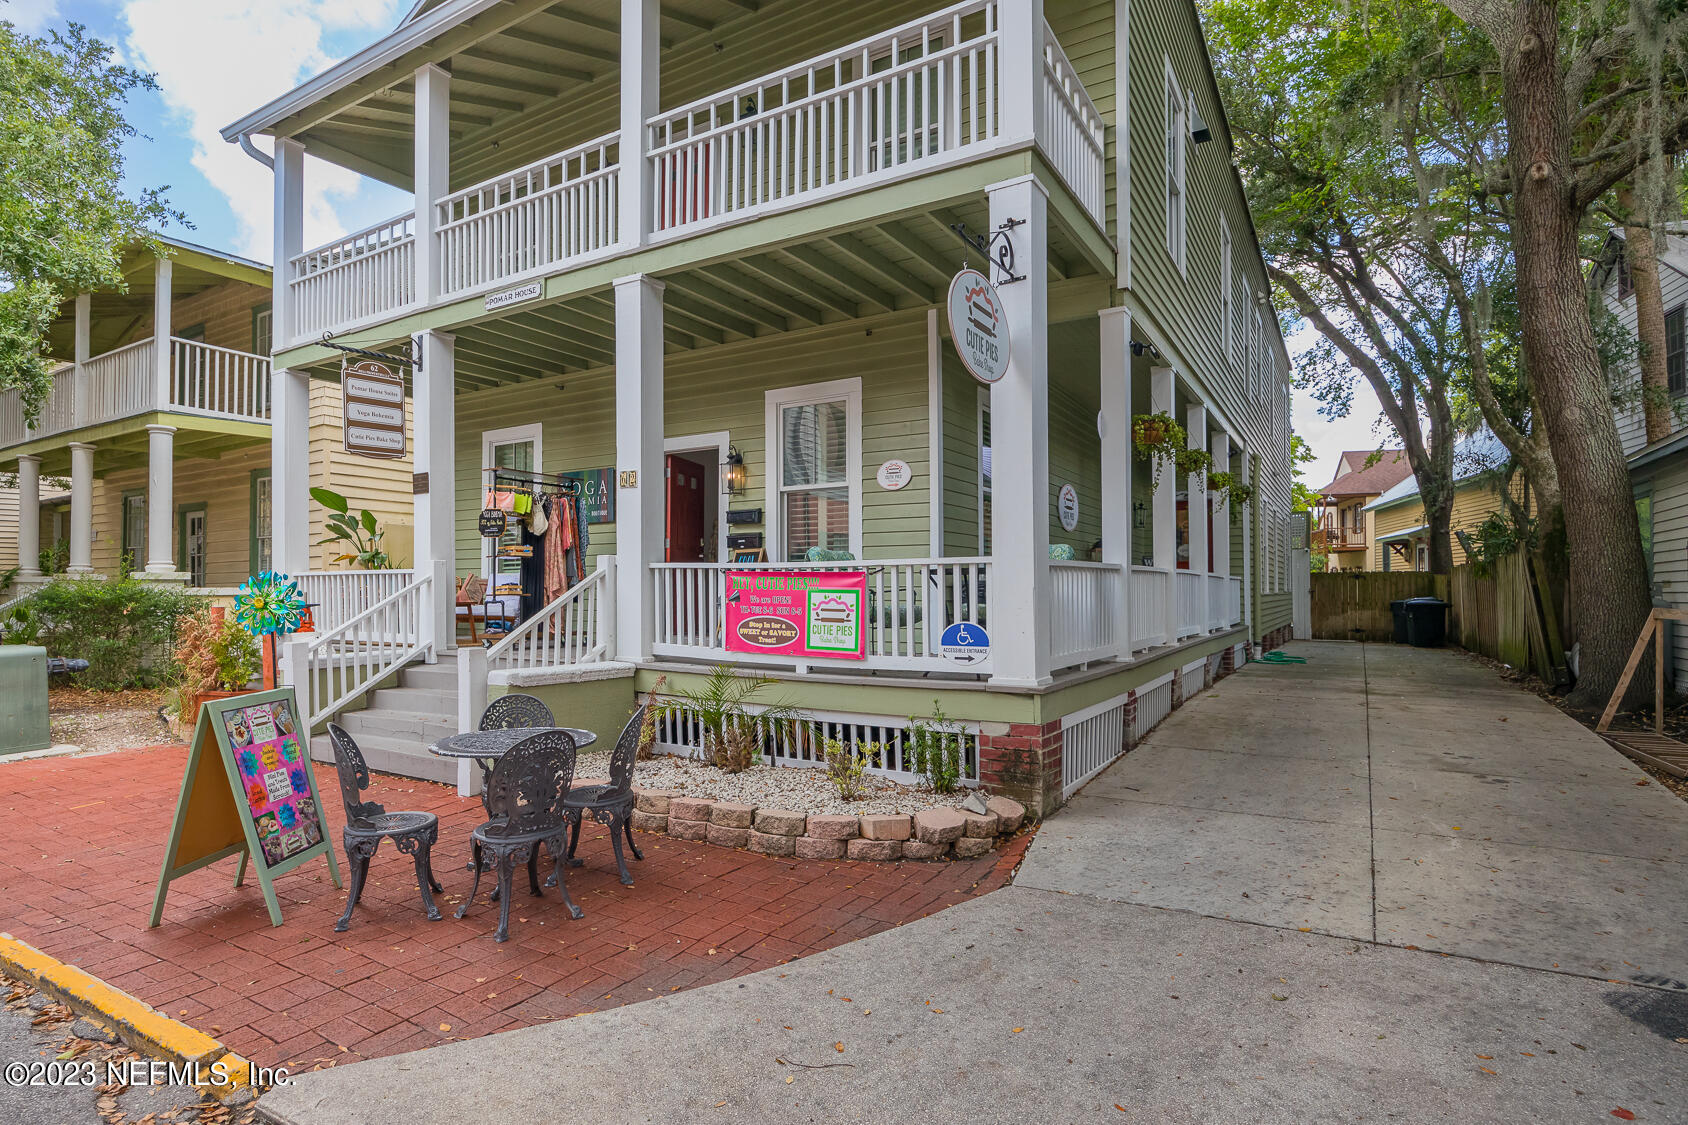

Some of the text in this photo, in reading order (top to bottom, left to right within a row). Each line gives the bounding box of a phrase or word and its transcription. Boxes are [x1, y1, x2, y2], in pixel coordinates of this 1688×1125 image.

[489, 286, 537, 306] POMAR HOUSE
[966, 327, 999, 363] CUTIE PIES
[732, 576, 754, 592] HEY,
[756, 577, 785, 590] CUTIE
[776, 606, 790, 615] SUN
[769, 629, 797, 637] SAVORY
[812, 624, 853, 637] CUTIE PIES
